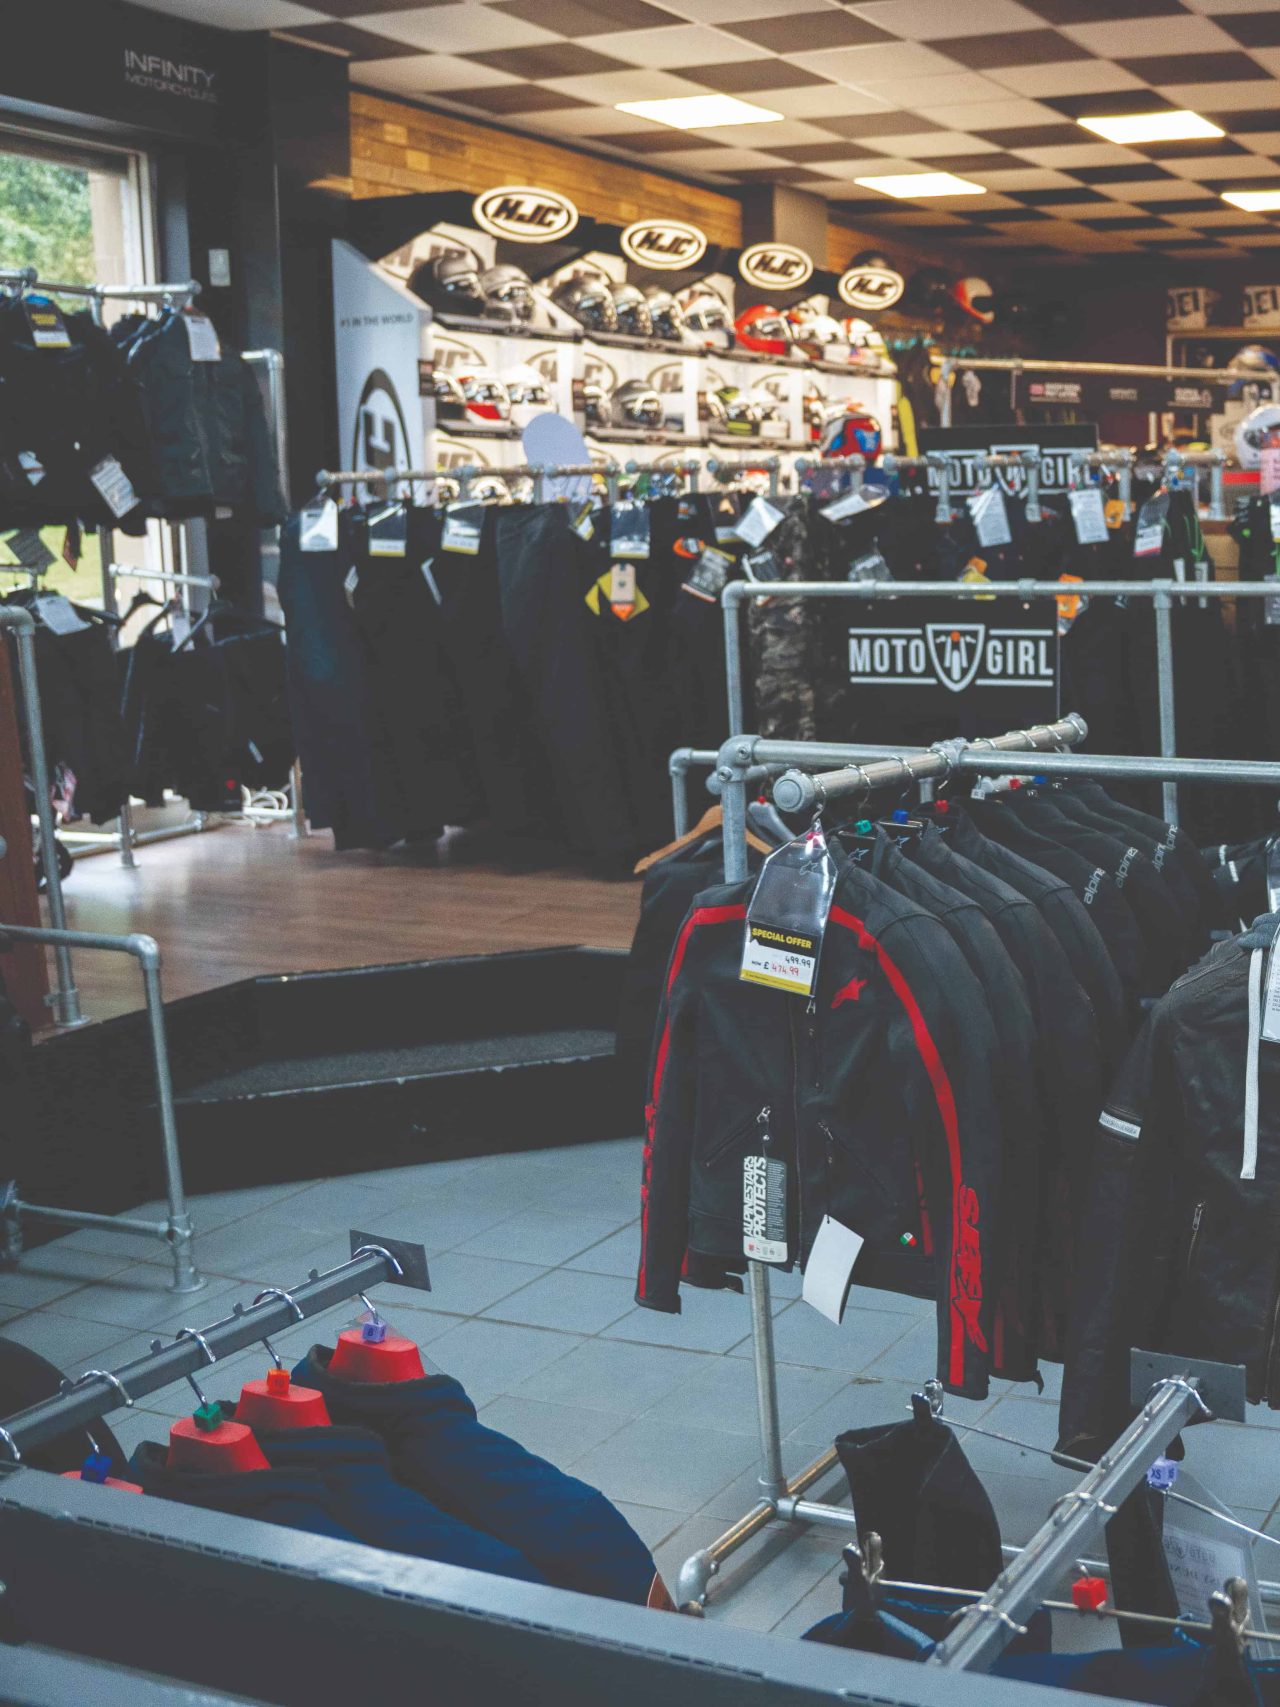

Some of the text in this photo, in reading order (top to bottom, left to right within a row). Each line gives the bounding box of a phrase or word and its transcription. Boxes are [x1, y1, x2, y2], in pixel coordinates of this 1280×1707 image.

[124, 48, 215, 87] INFINITY
[492, 198, 561, 227] HJC
[637, 231, 693, 256] HJC
[753, 253, 801, 276] HJC
[849, 637, 1054, 677] MOTO GIRL
[751, 927, 812, 949] SPECIAL OFFER
[743, 1155, 755, 1237] ALPINESTARS
[753, 1156, 767, 1241] PROTECTS
